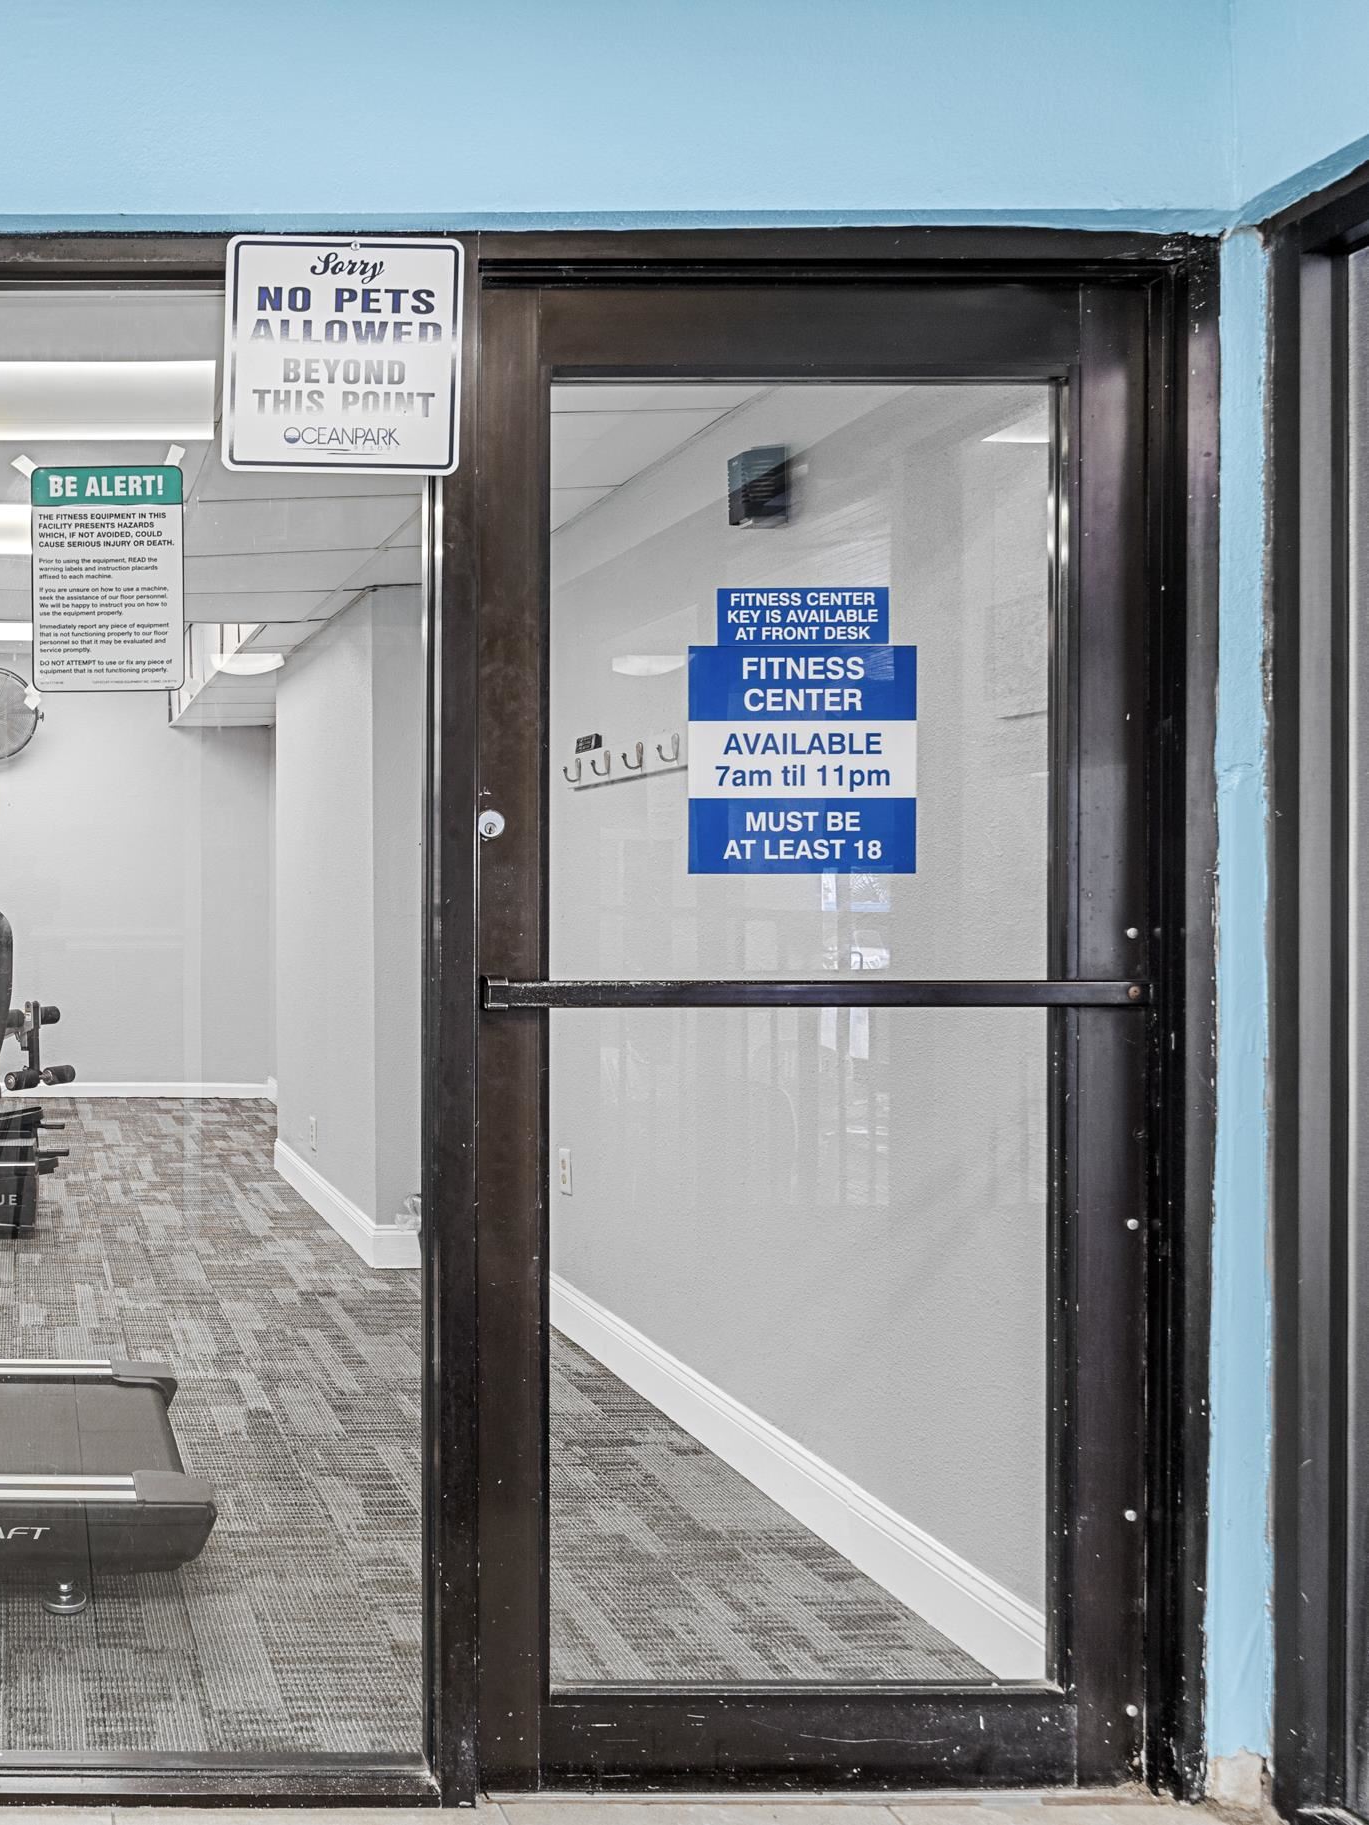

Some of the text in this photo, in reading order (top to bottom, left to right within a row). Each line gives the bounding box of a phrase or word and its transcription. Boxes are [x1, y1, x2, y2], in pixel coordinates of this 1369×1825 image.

[310, 252, 385, 284] Sorry
[257, 286, 435, 315] NO PETS
[250, 318, 442, 345] ALLOWED
[282, 357, 406, 385] BEYOND
[252, 389, 435, 418] THIS POINT
[283, 426, 400, 446] OCEANPARK
[48, 474, 164, 497] BE ALERT!
[136, 593, 168, 601] personnel.
[730, 592, 875, 606] FITNESS CENTER
[136, 622, 169, 630] equipment
[727, 609, 878, 623] KEY IS AVAILABLE
[71, 631, 106, 639] functioning
[735, 626, 871, 640] AT FRONT DESK
[63, 647, 92, 655] promptly.
[141, 667, 168, 675] properly.
[742, 656, 865, 680] FITNESS
[743, 688, 863, 712] CENTER
[723, 733, 883, 755] AVAILABLE
[715, 765, 891, 792] 7am til 11pm
[745, 811, 861, 832] MUST BE
[723, 839, 882, 860] AT LEAST 18
